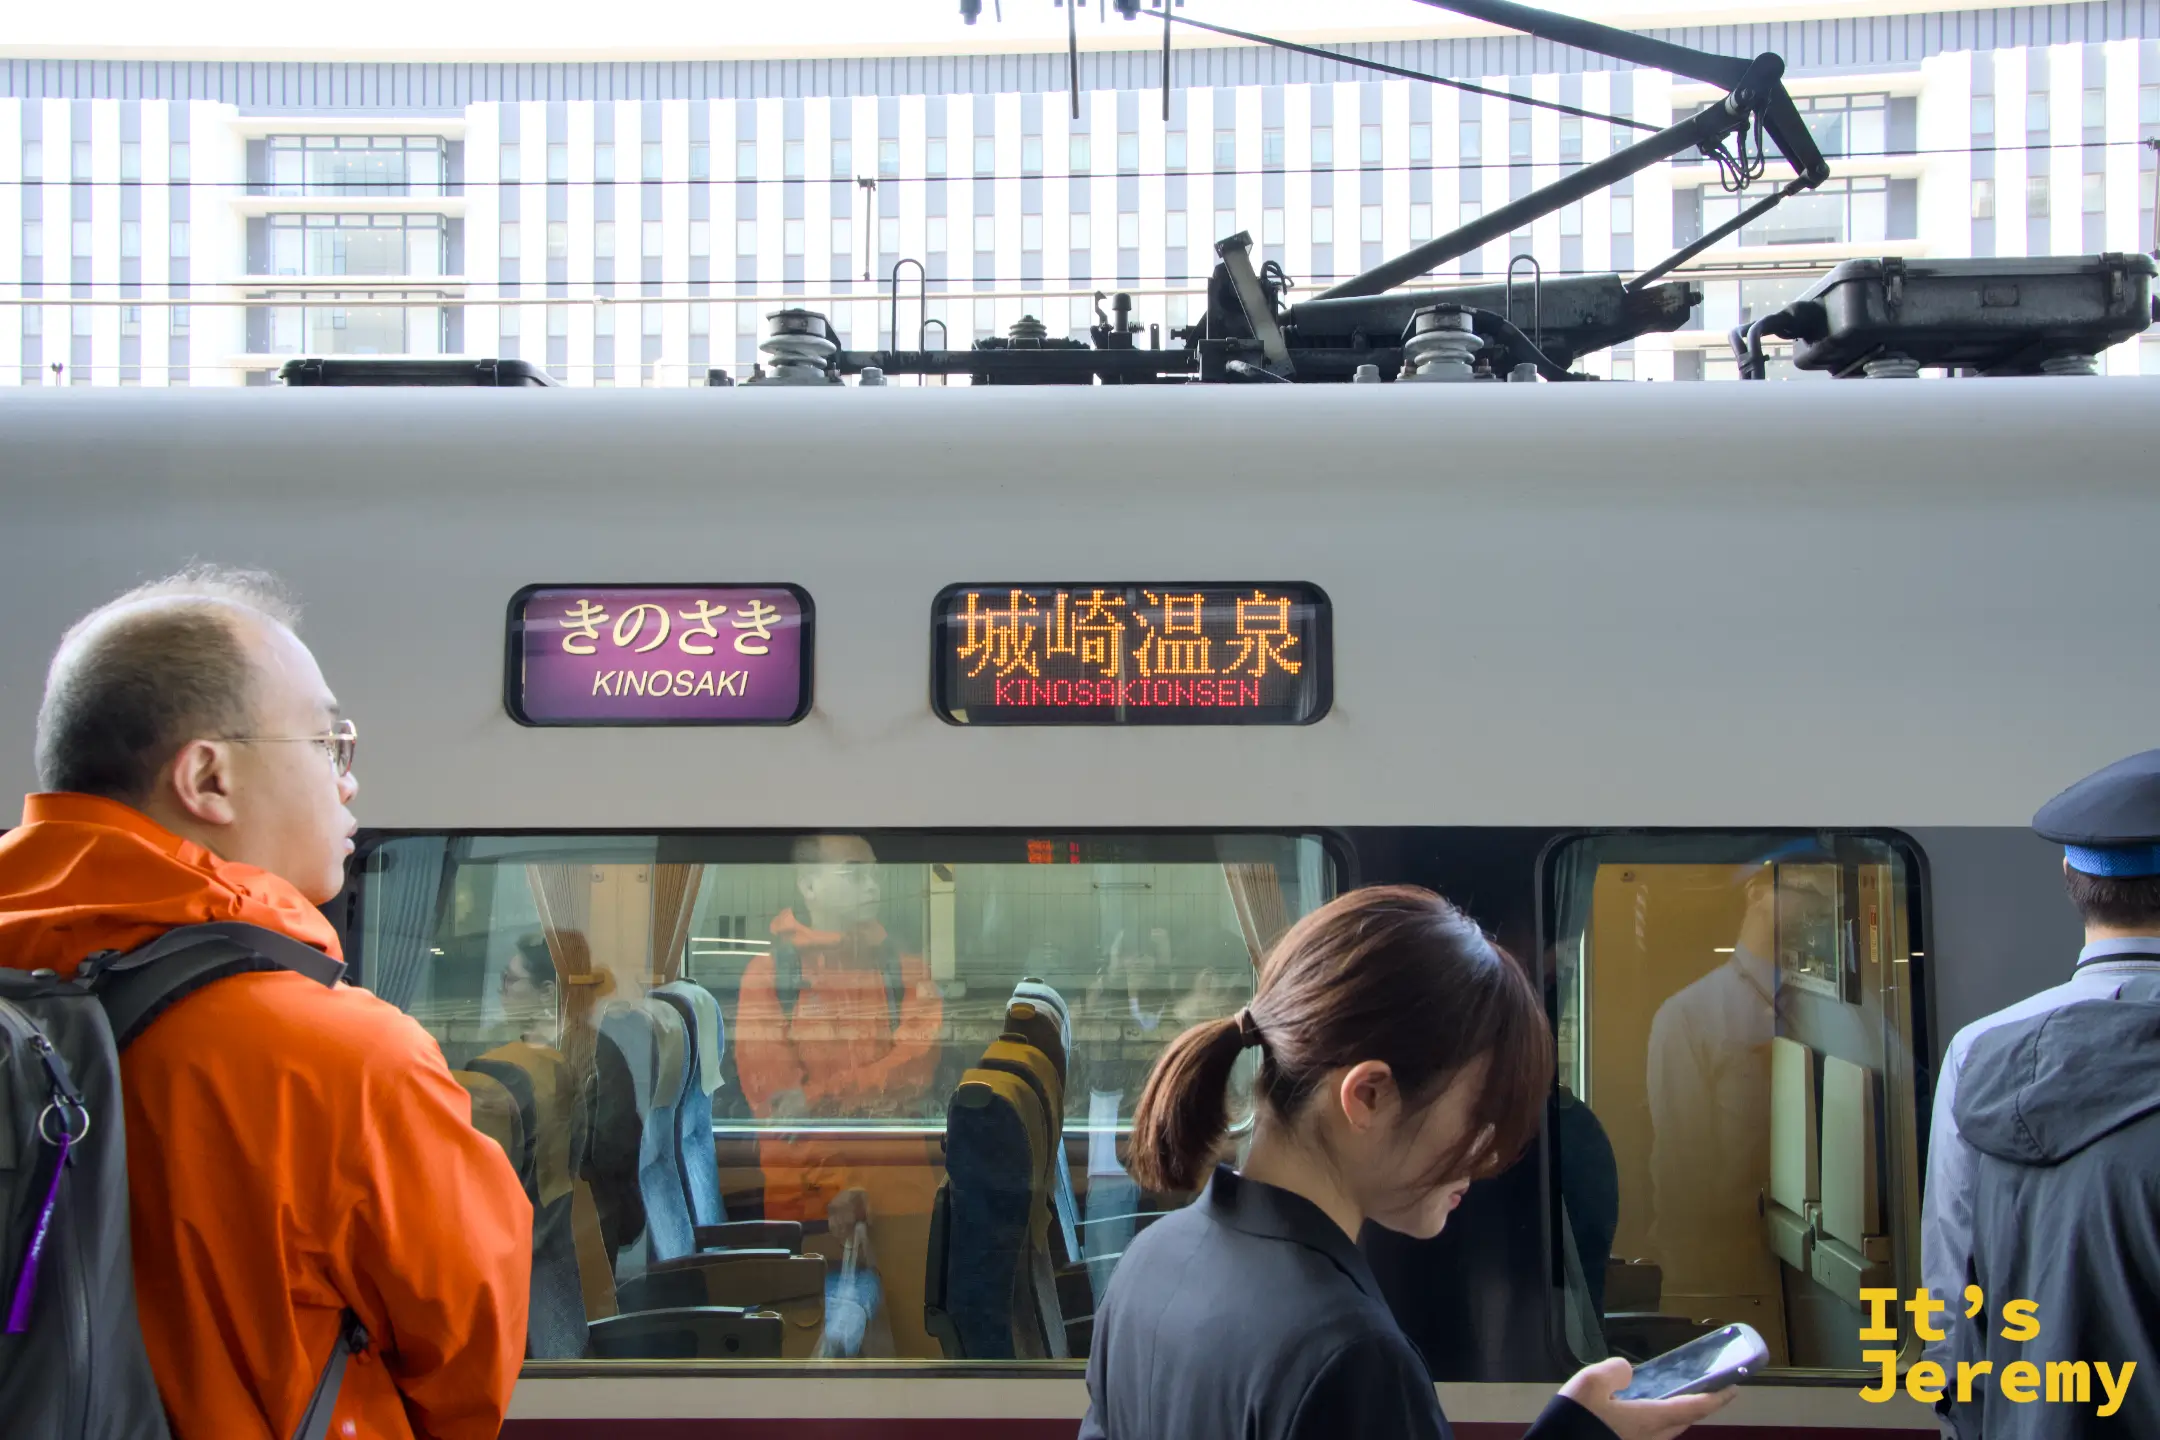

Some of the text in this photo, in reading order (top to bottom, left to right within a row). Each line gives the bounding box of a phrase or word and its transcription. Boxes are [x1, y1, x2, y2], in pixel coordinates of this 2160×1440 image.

[558, 599, 783, 656] きのさき
[956, 589, 1302, 678] 城崎温泉
[591, 669, 750, 697] KINOSAKI
[995, 679, 1260, 706] KINOSAKIONSEN
